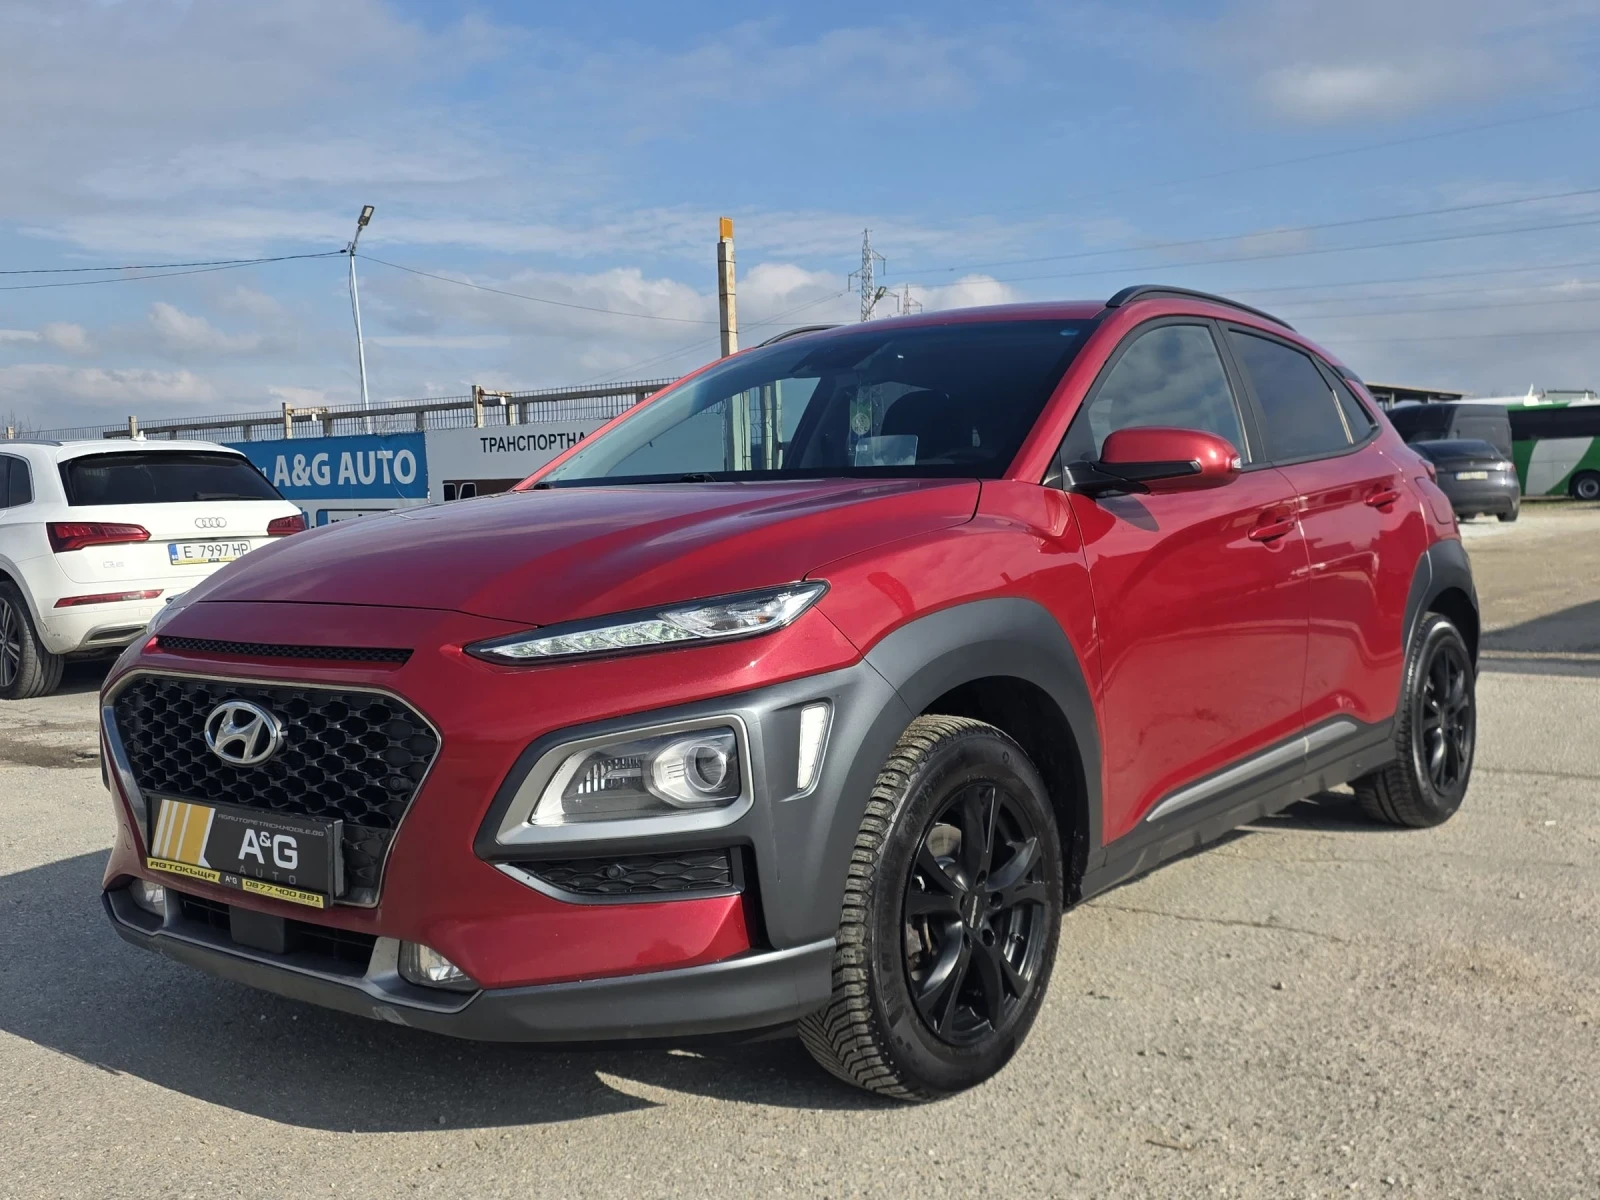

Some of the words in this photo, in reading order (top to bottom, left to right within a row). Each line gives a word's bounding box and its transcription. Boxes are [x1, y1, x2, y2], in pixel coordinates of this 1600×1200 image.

[273, 452, 331, 487] A&G
[337, 449, 417, 485] AUTO
[183, 545, 193, 559] E
[198, 544, 229, 558] 7997
[238, 828, 298, 870] A&G
[150, 861, 216, 879] АВТОКЪЩА
[239, 865, 297, 885] AUTO
[245, 880, 273, 892] 0877
[275, 887, 297, 898] 400
[298, 892, 321, 903] 881
